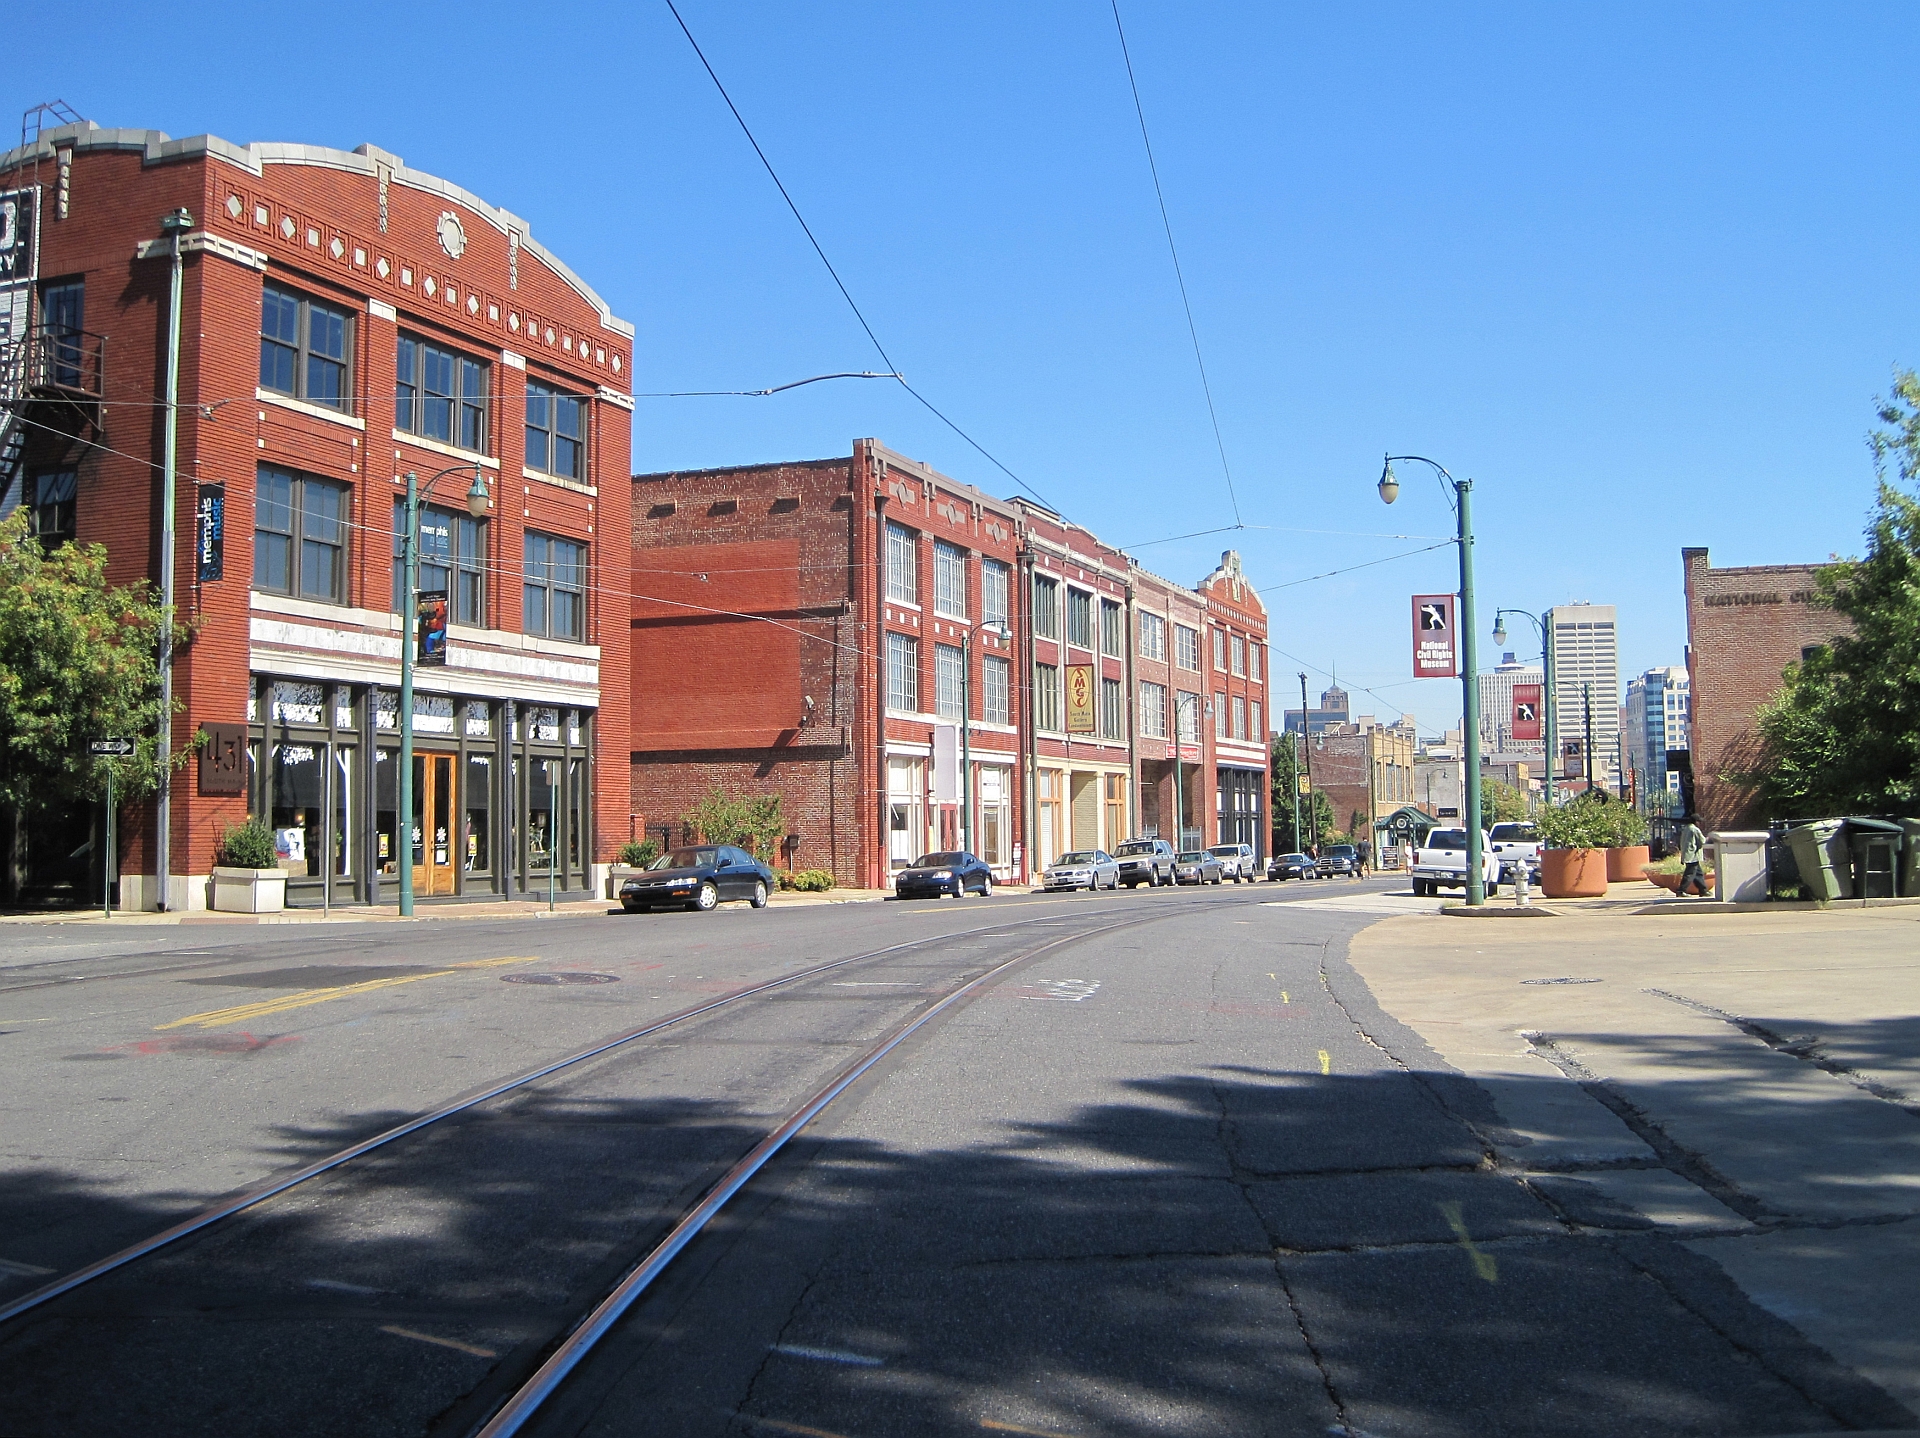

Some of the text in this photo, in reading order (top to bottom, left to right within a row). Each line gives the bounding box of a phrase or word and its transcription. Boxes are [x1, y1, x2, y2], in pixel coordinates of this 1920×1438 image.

[211, 498, 222, 540] music
[197, 498, 214, 564] memphis
[1704, 592, 1783, 606] NATIONAL
[1420, 641, 1449, 650] National
[1416, 650, 1453, 660] Civil Rights
[1420, 660, 1450, 669] Museum
[207, 732, 242, 773] 431
